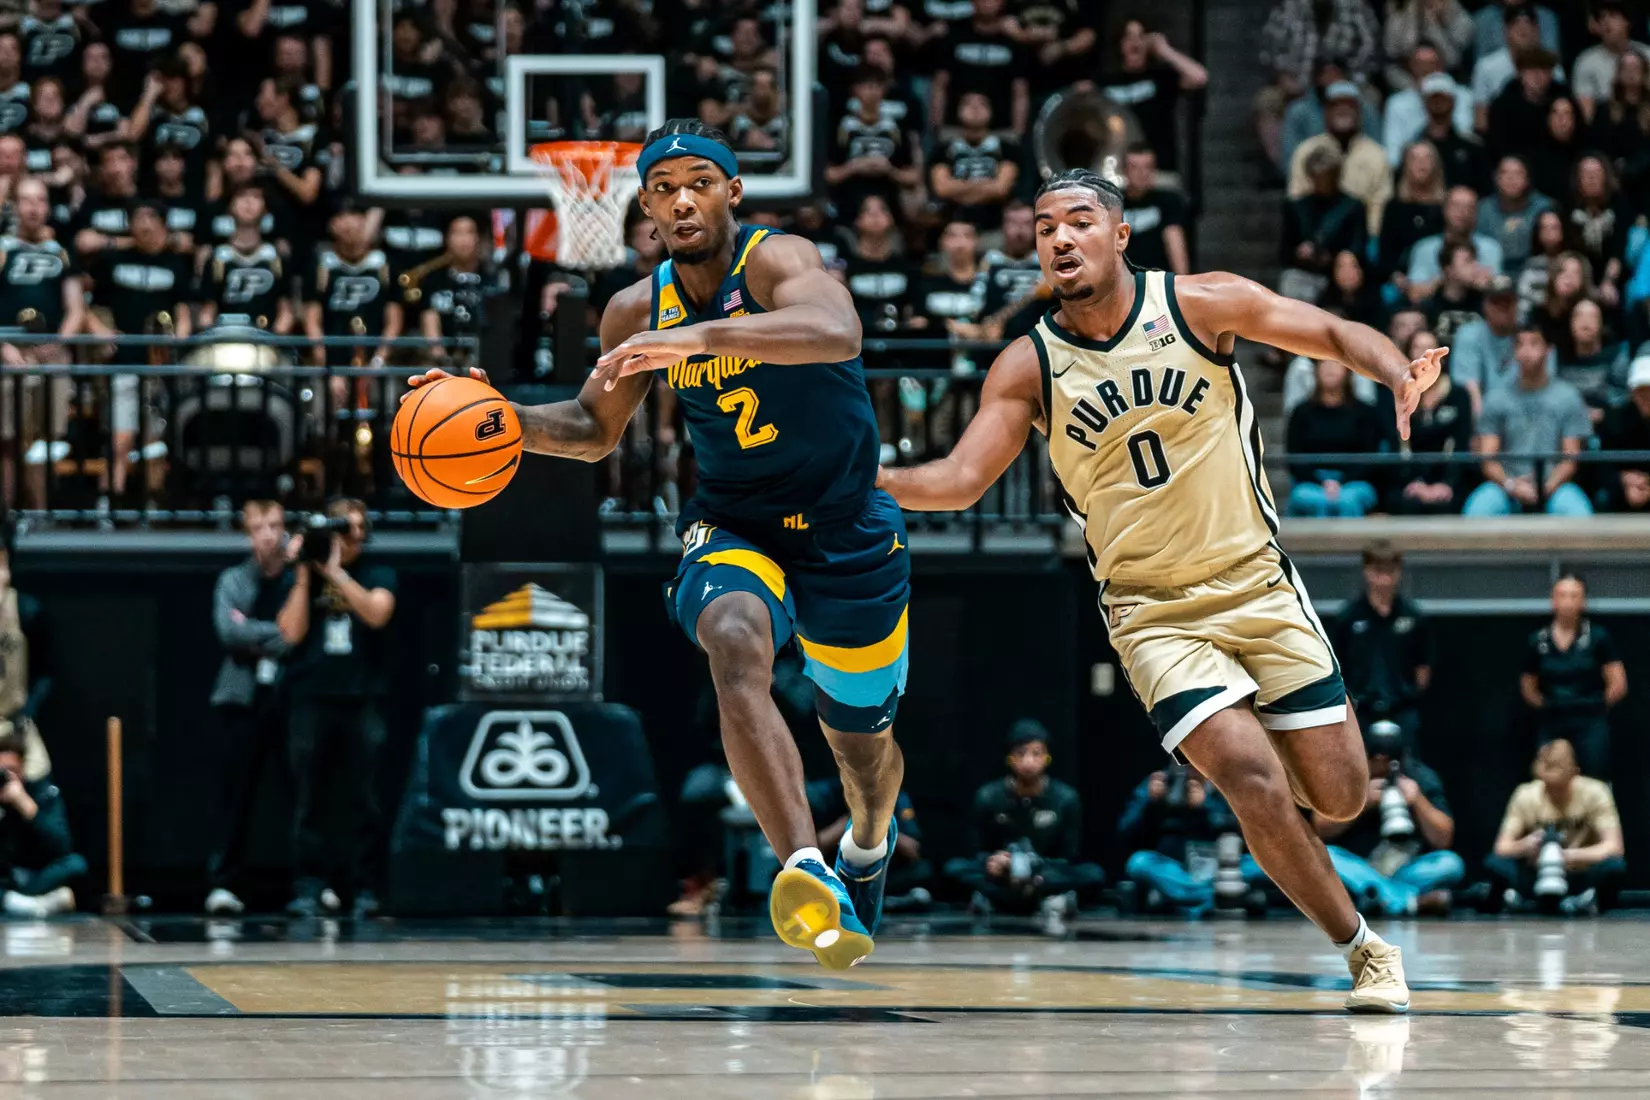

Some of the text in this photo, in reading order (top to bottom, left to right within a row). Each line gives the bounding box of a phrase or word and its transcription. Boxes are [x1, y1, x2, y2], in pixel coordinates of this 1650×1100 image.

[716, 386, 779, 450] 2
[1065, 367, 1211, 451] PURDUE
[471, 630, 589, 653] PURDUE
